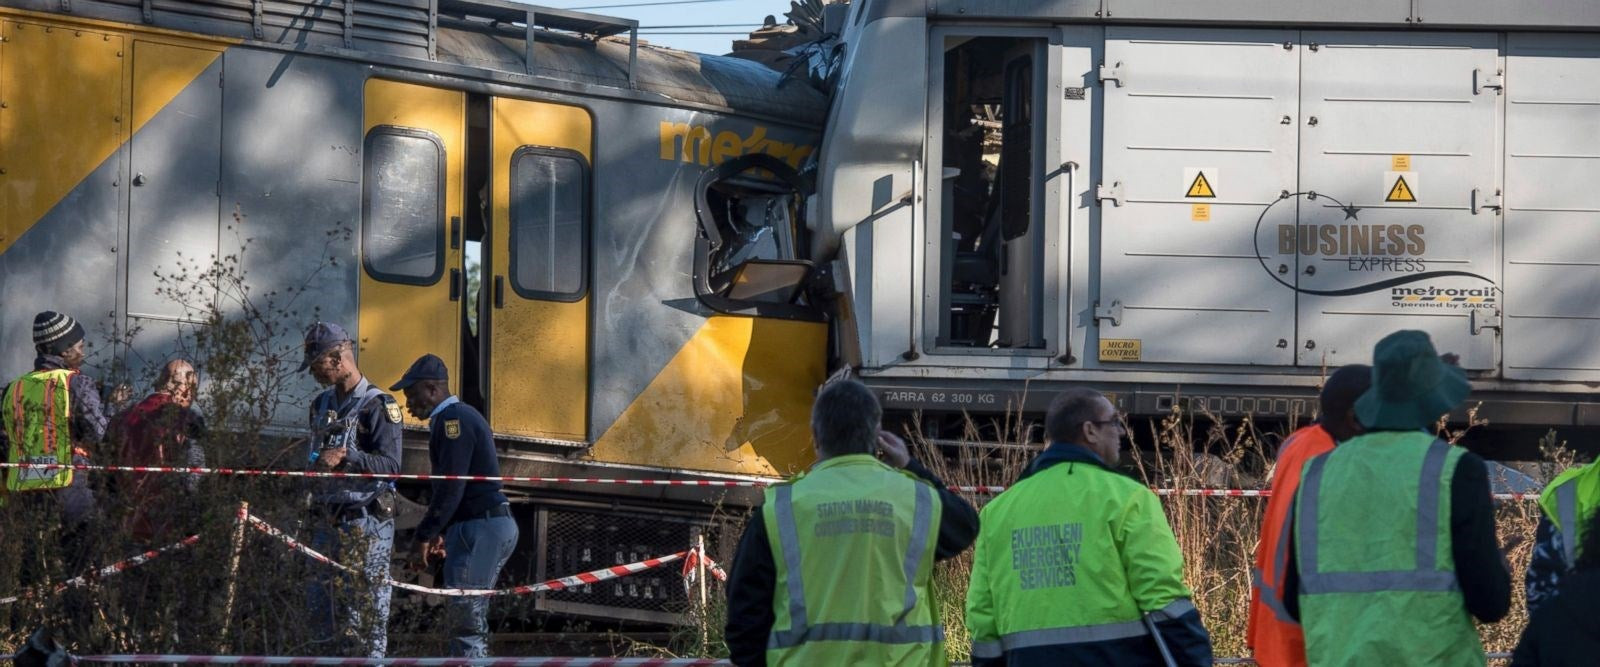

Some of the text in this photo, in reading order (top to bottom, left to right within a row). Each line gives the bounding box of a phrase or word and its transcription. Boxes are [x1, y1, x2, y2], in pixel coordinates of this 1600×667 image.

[1278, 223, 1426, 257] BUSINESS
[1348, 256, 1426, 273] EXPRESS
[1391, 285, 1496, 297] metrorail
[1391, 301, 1443, 309] Operated
[1101, 349, 1140, 357] CONTROL
[1107, 341, 1135, 349] MICRO
[884, 391, 995, 404] TARRA 62 300 KG
[816, 499, 894, 520] STATION MANAGER
[1011, 522, 1083, 550] EKURHULENI
[1012, 543, 1082, 571] EMERGENCY
[1020, 565, 1077, 591] SERVICES
